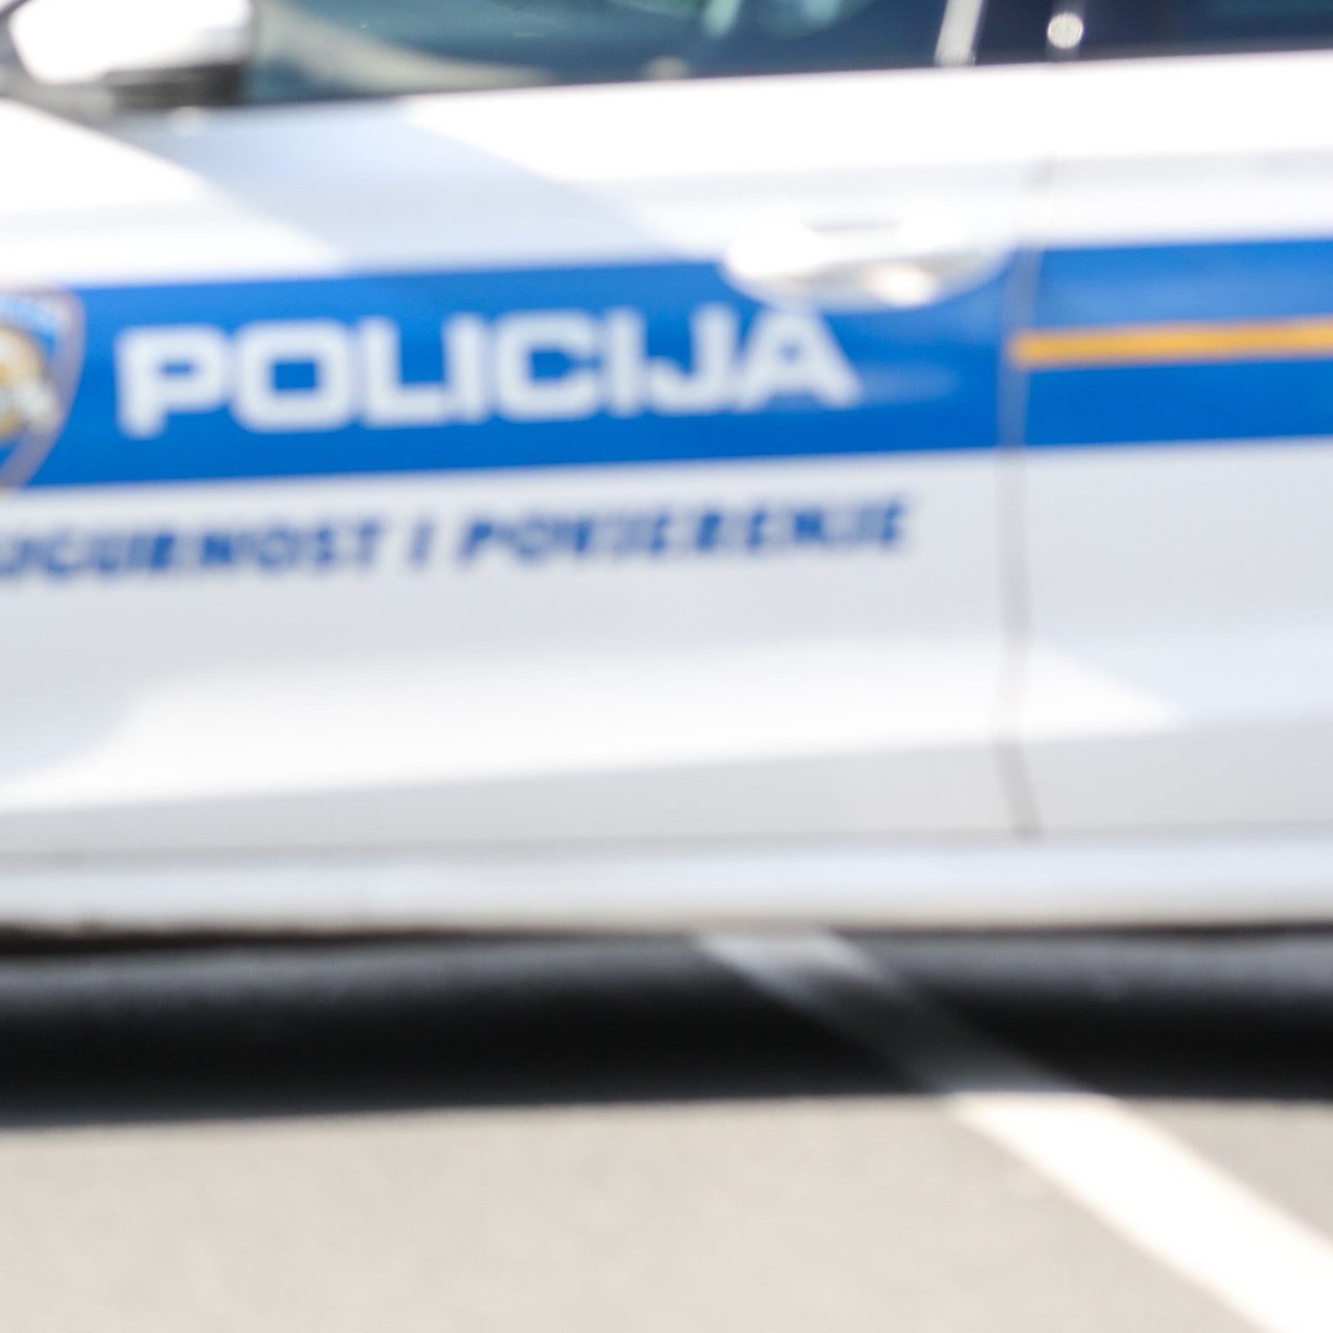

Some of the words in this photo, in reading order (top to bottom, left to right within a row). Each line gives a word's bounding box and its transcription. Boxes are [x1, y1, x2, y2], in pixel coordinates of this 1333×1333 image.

[117, 304, 863, 438] POLICIJA
[407, 516, 439, 568] I
[459, 496, 911, 566] POVJERENJE
